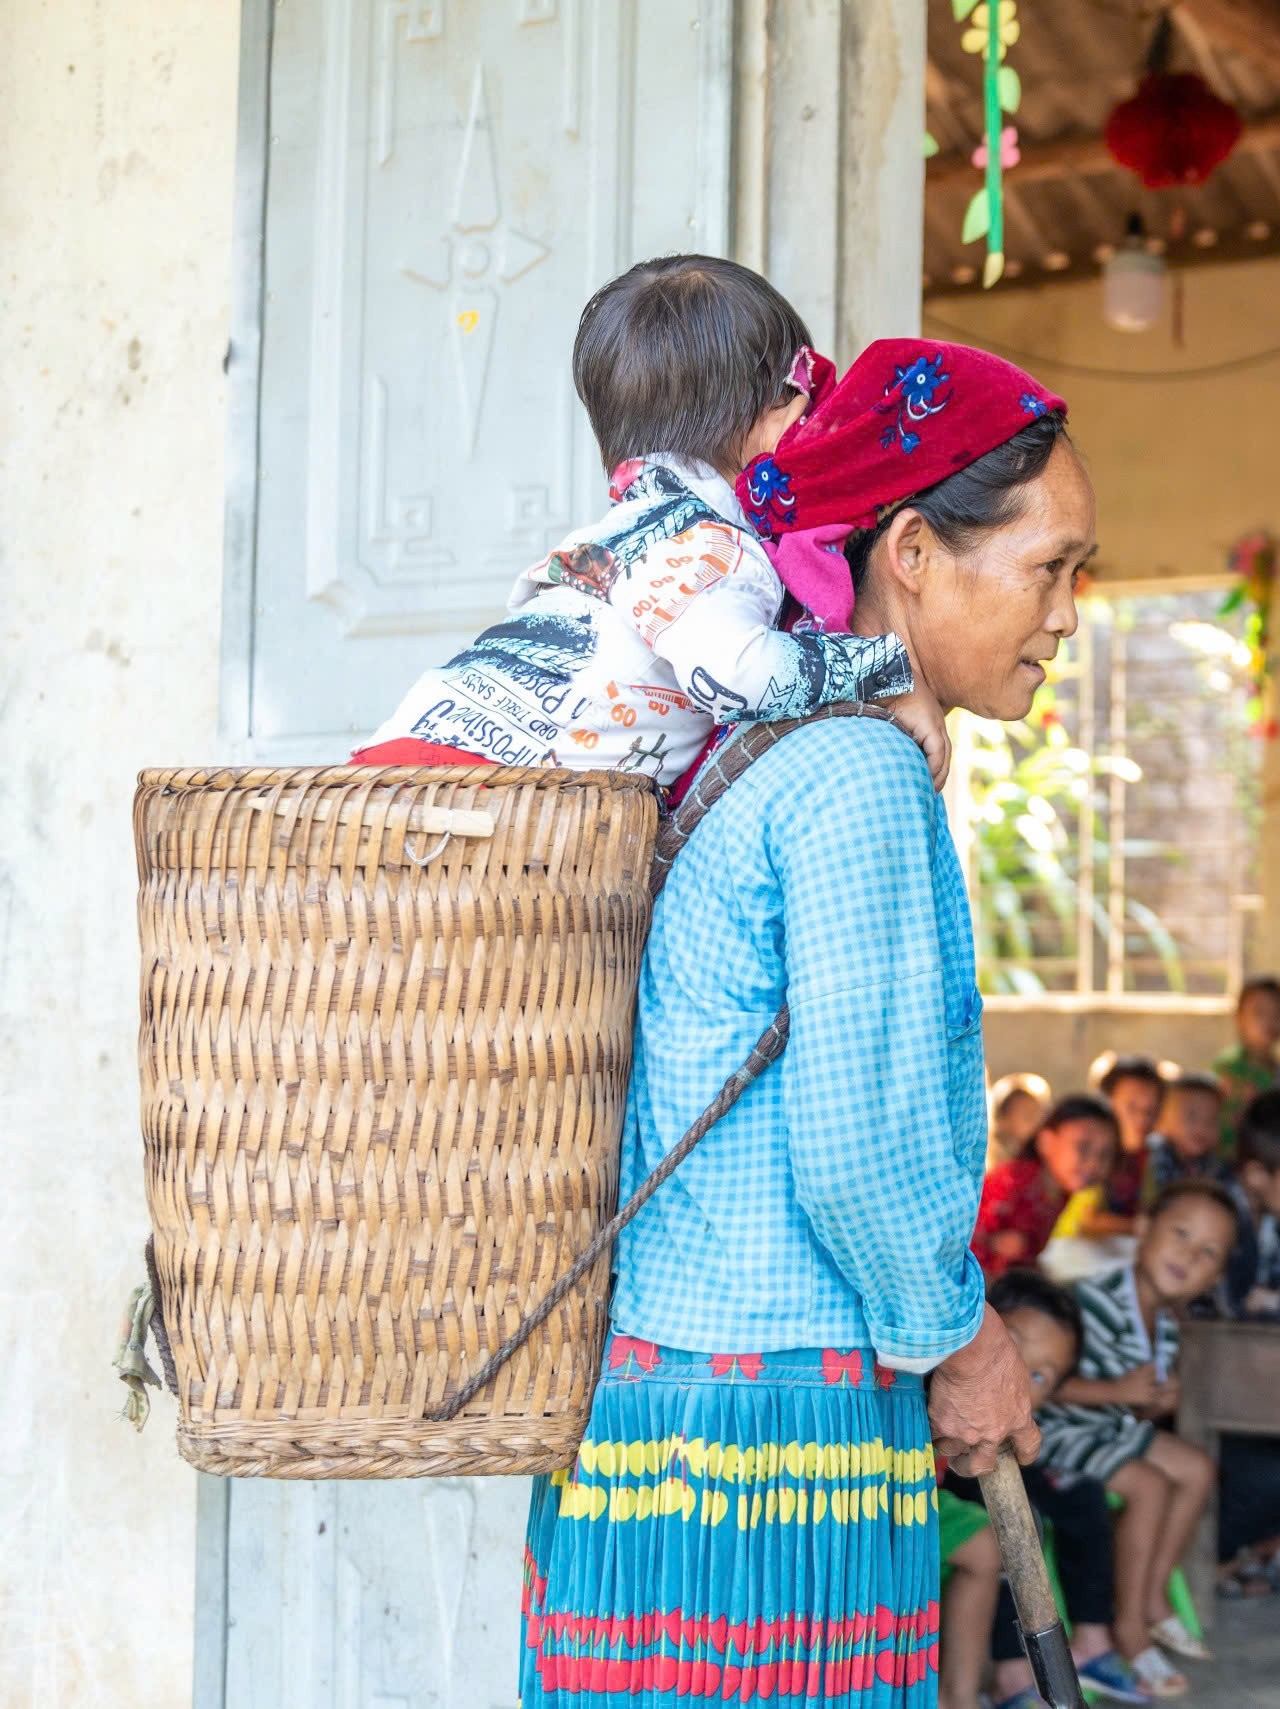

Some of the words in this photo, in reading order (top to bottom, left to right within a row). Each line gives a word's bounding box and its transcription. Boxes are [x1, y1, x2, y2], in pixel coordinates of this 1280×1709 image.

[632, 594, 660, 618] 100
[462, 673, 496, 700] SAYS
[611, 703, 637, 727] 60
[570, 728, 599, 750] 40
